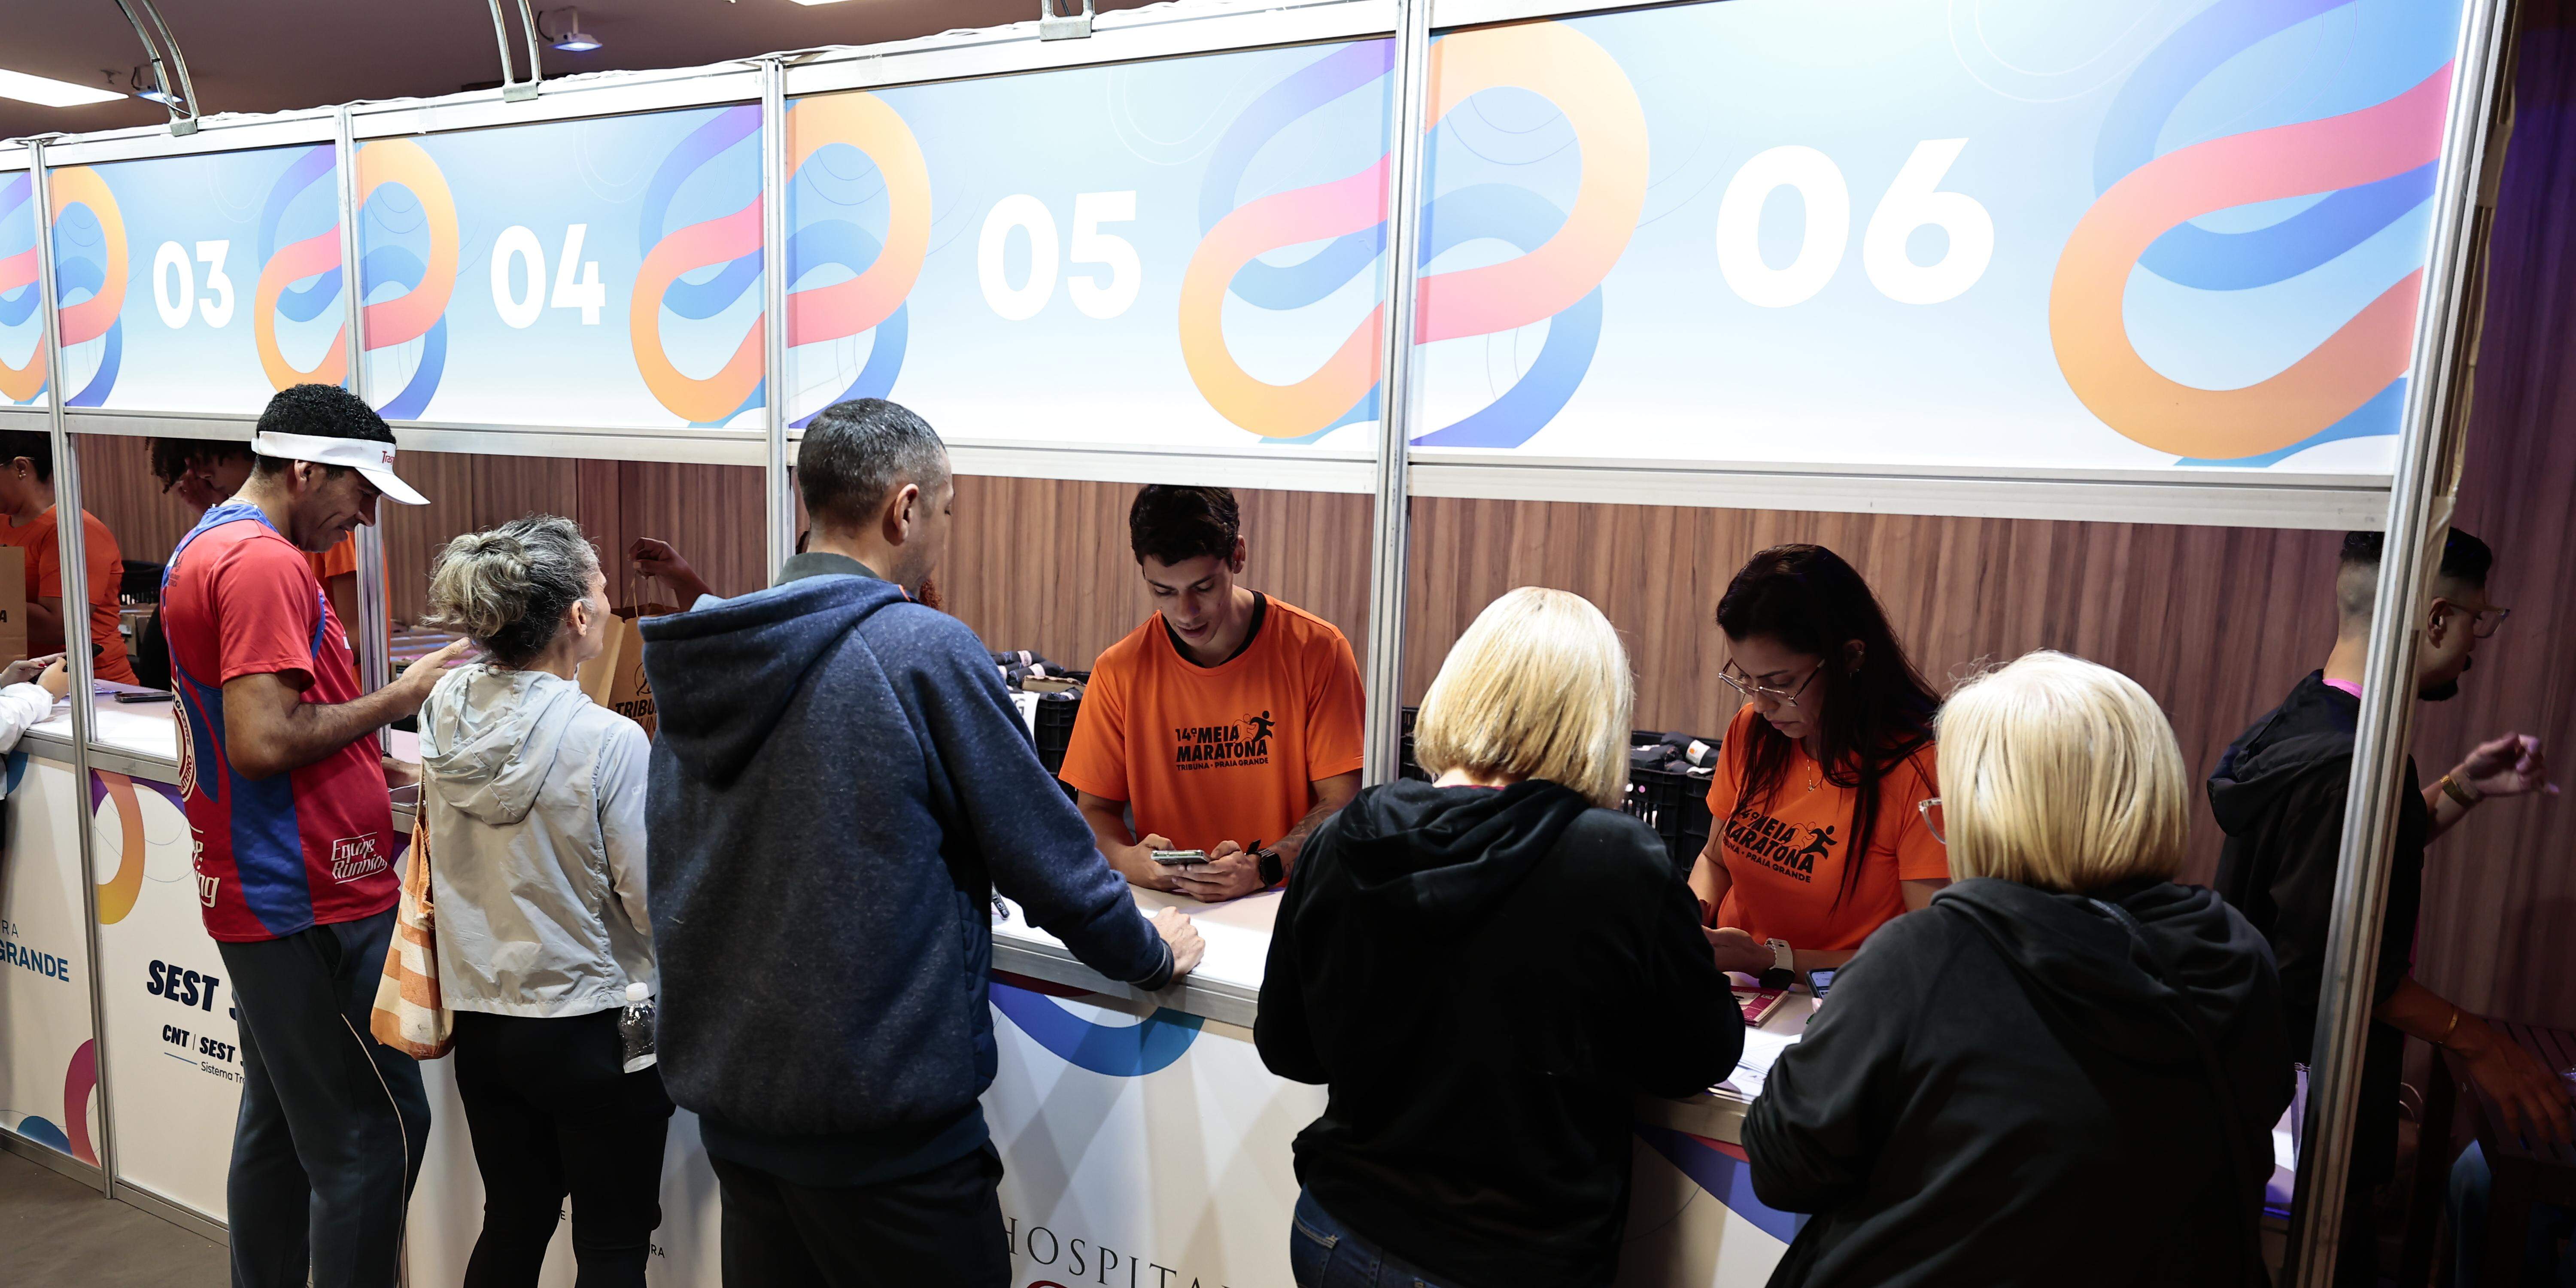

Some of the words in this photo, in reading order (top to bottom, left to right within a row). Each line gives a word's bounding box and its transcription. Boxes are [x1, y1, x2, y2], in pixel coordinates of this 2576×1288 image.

[1716, 137, 1994, 308] 06
[978, 190, 1141, 321] 05
[153, 240, 234, 329] 03
[491, 223, 606, 329] 04
[615, 699, 657, 719] TRIBU
[1176, 739, 1267, 762] MARATONA
[1197, 726, 1239, 744] MEIA
[1176, 762, 1209, 771] TRIBUNA
[1215, 759, 1237, 769] PRAIA
[1238, 757, 1269, 766] GRANDE
[331, 832, 377, 863] Equipe
[1746, 852, 1771, 869] PRAIA
[1772, 863, 1811, 883] GRANDE
[147, 960, 219, 1012] SEST
[162, 1024, 190, 1048] CNT
[199, 1036, 236, 1063] SEST
[201, 1061, 233, 1080] Sistema
[1006, 1217, 1230, 1288] OSPIT
